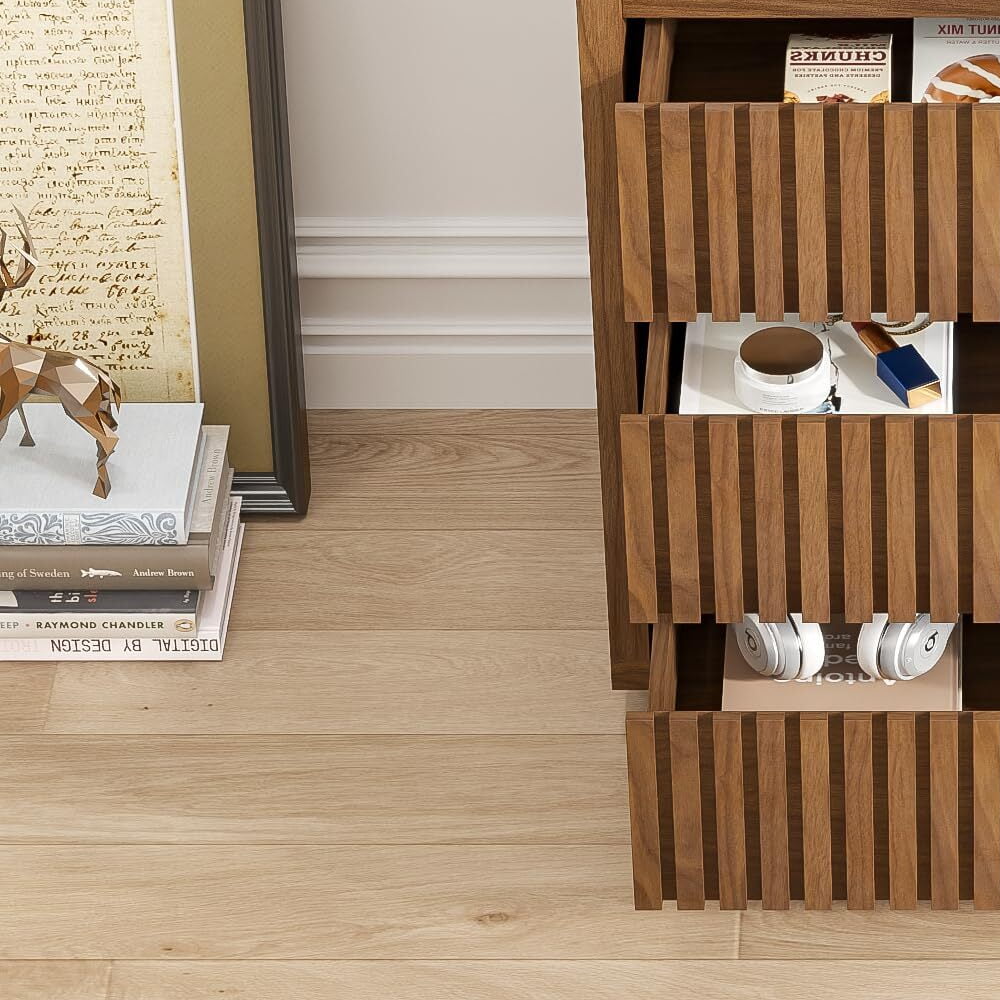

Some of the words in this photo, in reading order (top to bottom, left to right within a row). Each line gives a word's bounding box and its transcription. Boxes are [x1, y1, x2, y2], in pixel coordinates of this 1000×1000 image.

[207, 448, 222, 473] Brown
[202, 476, 215, 504] Andrew
[17, 568, 28, 577] of
[29, 568, 71, 578] Sweden
[133, 568, 165, 577] Andrew
[167, 568, 195, 577] Brown
[36, 621, 97, 629] RAYMOND
[102, 621, 164, 629] CHANDLER
[50, 639, 112, 653] DESIGN
[123, 639, 142, 652] BY
[152, 639, 219, 652] DIGITAL
